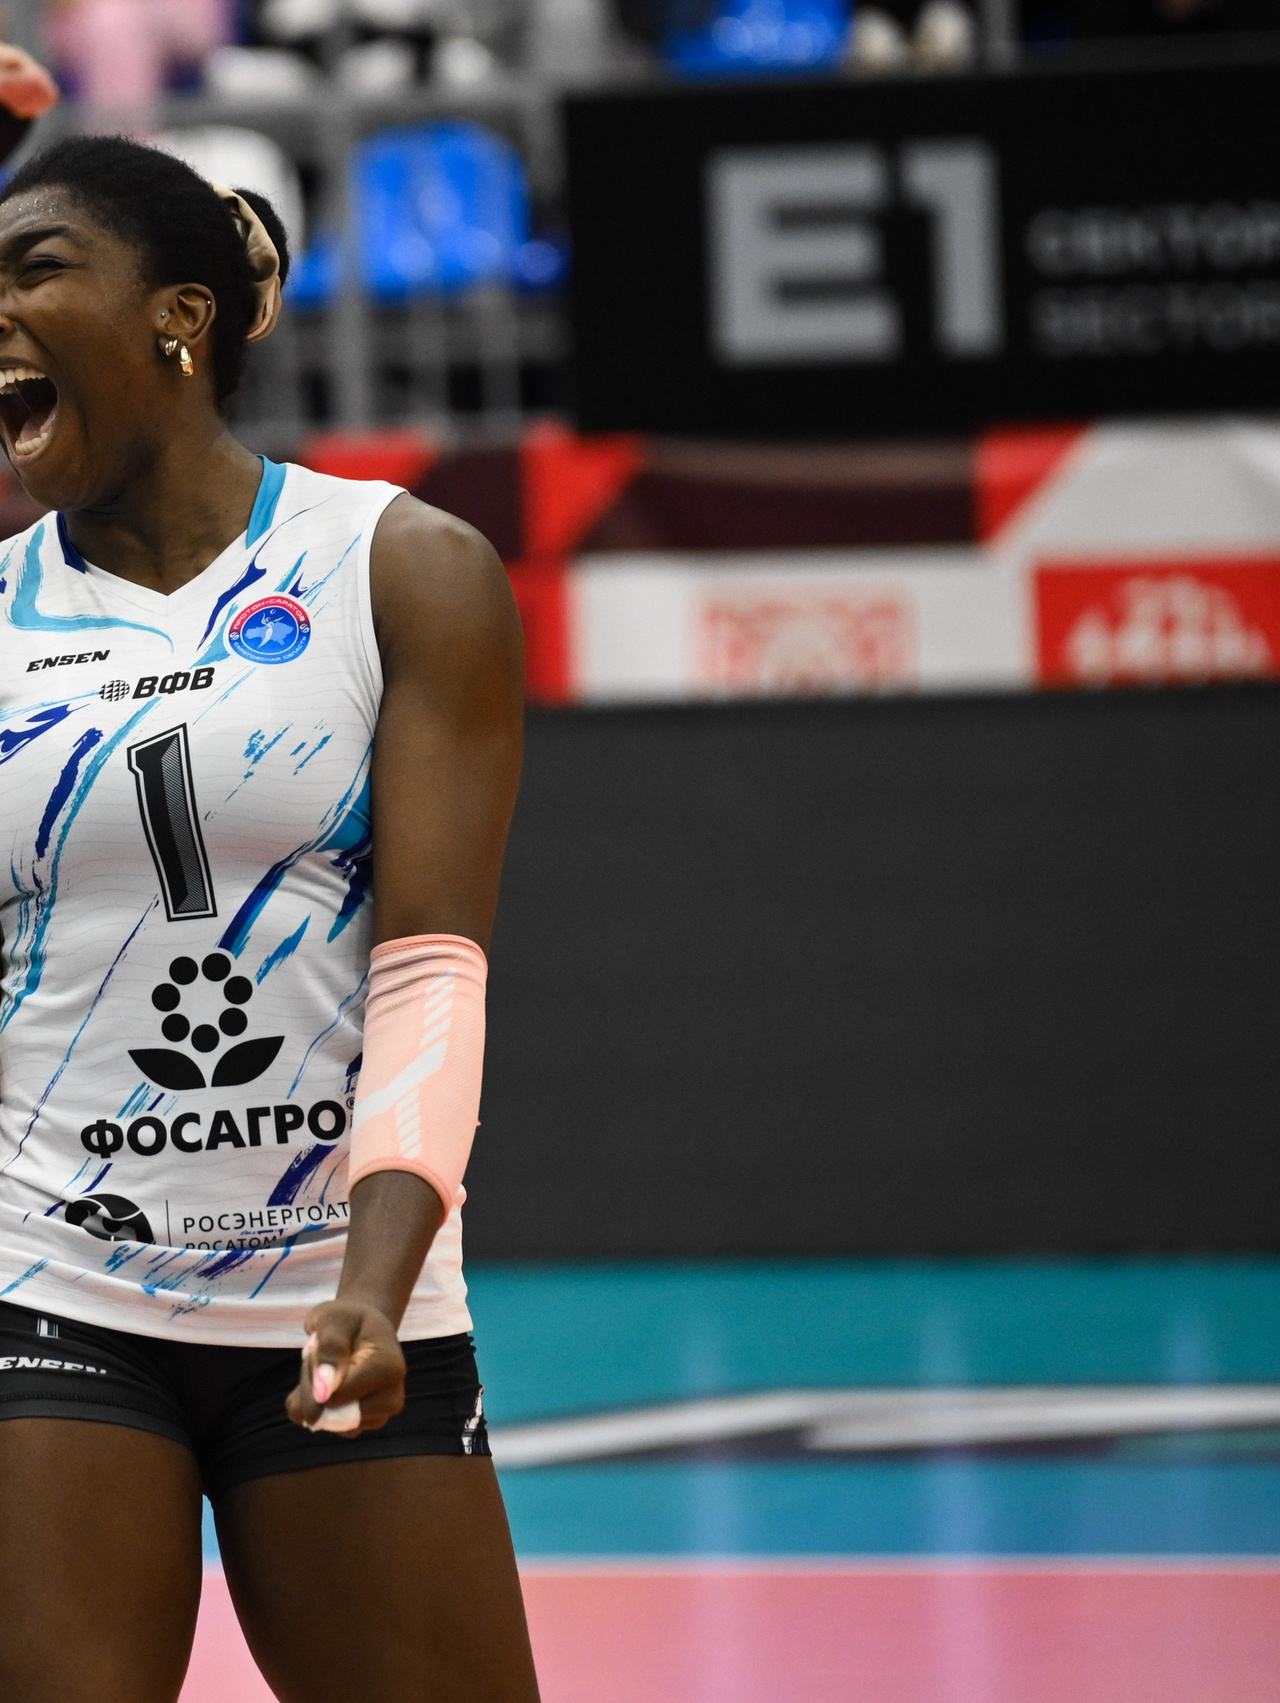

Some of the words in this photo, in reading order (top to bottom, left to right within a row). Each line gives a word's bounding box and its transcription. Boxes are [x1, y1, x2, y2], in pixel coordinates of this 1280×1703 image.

[707, 138, 1004, 368] E1
[233, 598, 306, 630] ПРОТОН-САРАТОВ
[25, 649, 111, 673] ENSEN
[132, 667, 215, 700] ВФВ
[126, 722, 218, 922] 1
[80, 1100, 347, 1159] ФОСАГРО
